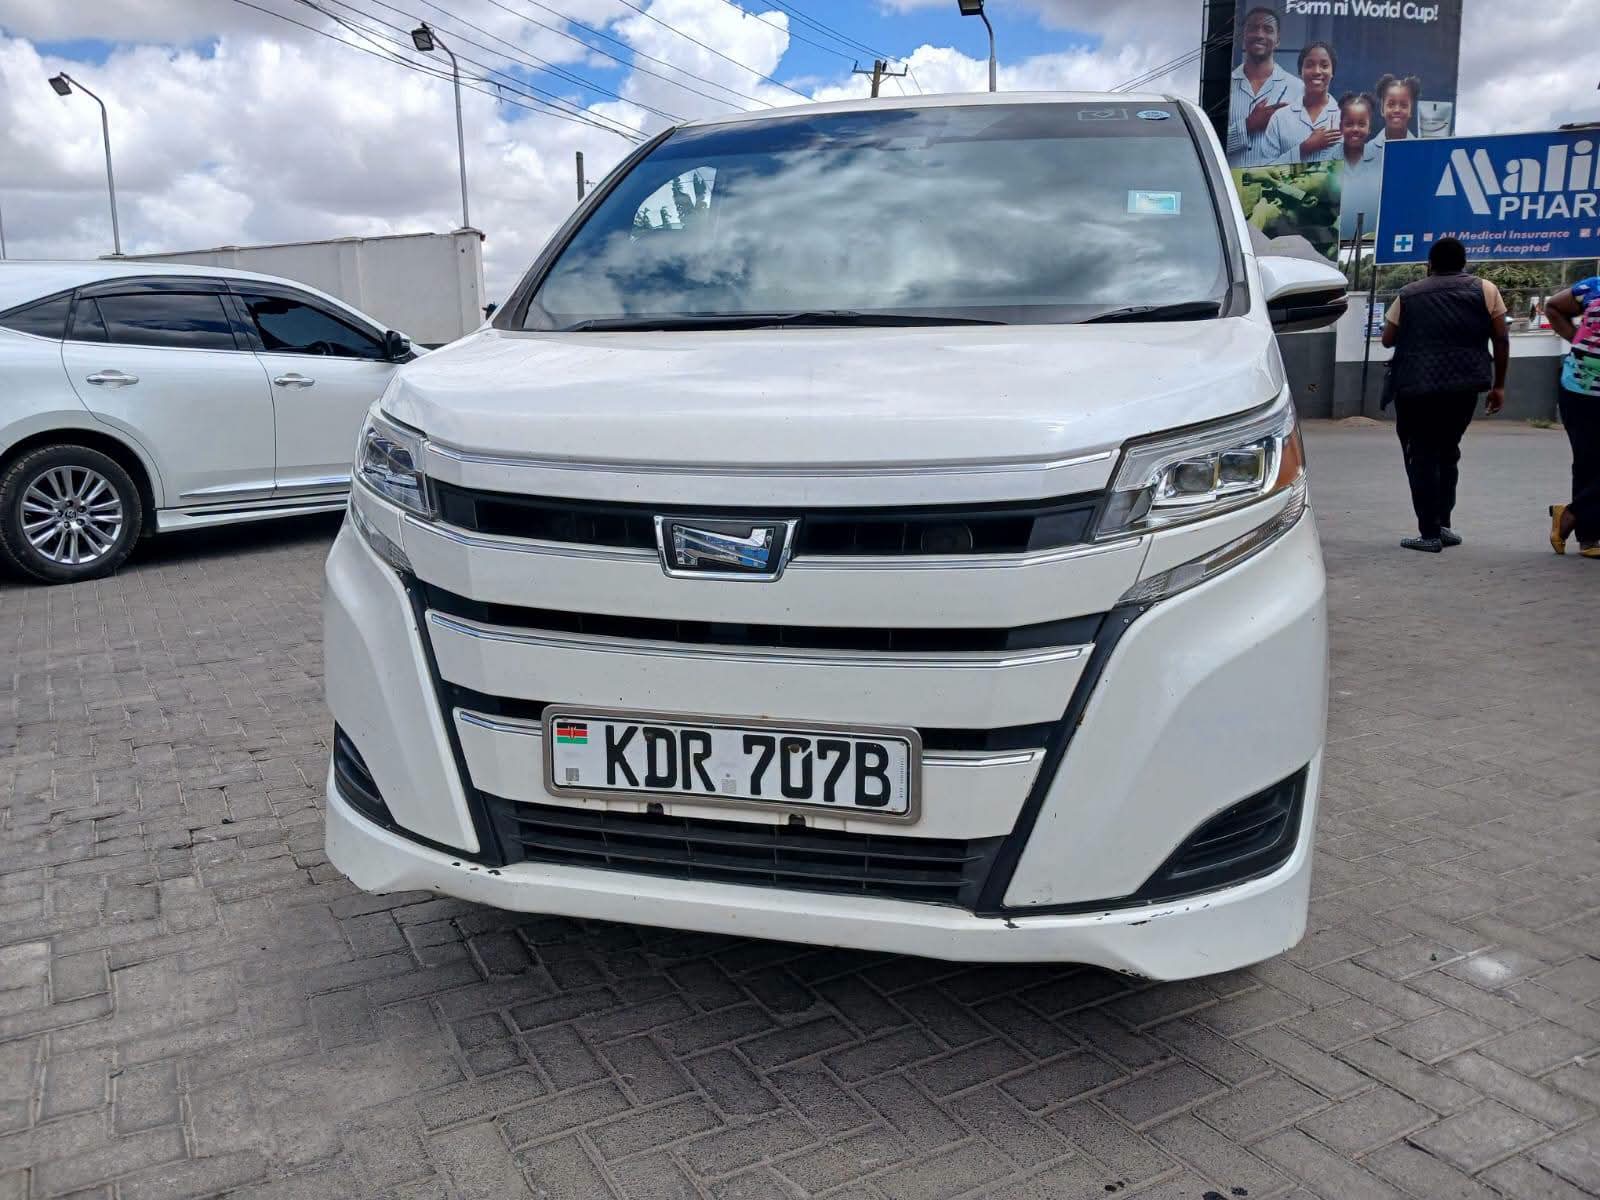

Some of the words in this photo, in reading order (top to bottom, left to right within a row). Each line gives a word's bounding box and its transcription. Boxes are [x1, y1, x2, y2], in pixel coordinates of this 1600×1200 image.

[1286, 0, 1331, 15] Form
[1334, 0, 1349, 16] ni
[1352, 0, 1400, 18] World
[1403, 3, 1439, 23] Cup!
[1434, 140, 1600, 215] Mali
[1458, 231, 1506, 241] Medical
[1509, 230, 1570, 239] Insurance
[1464, 244, 1490, 254] ards
[1493, 243, 1551, 255] Accepted
[604, 724, 716, 792] KDR
[742, 734, 892, 807] 707B
